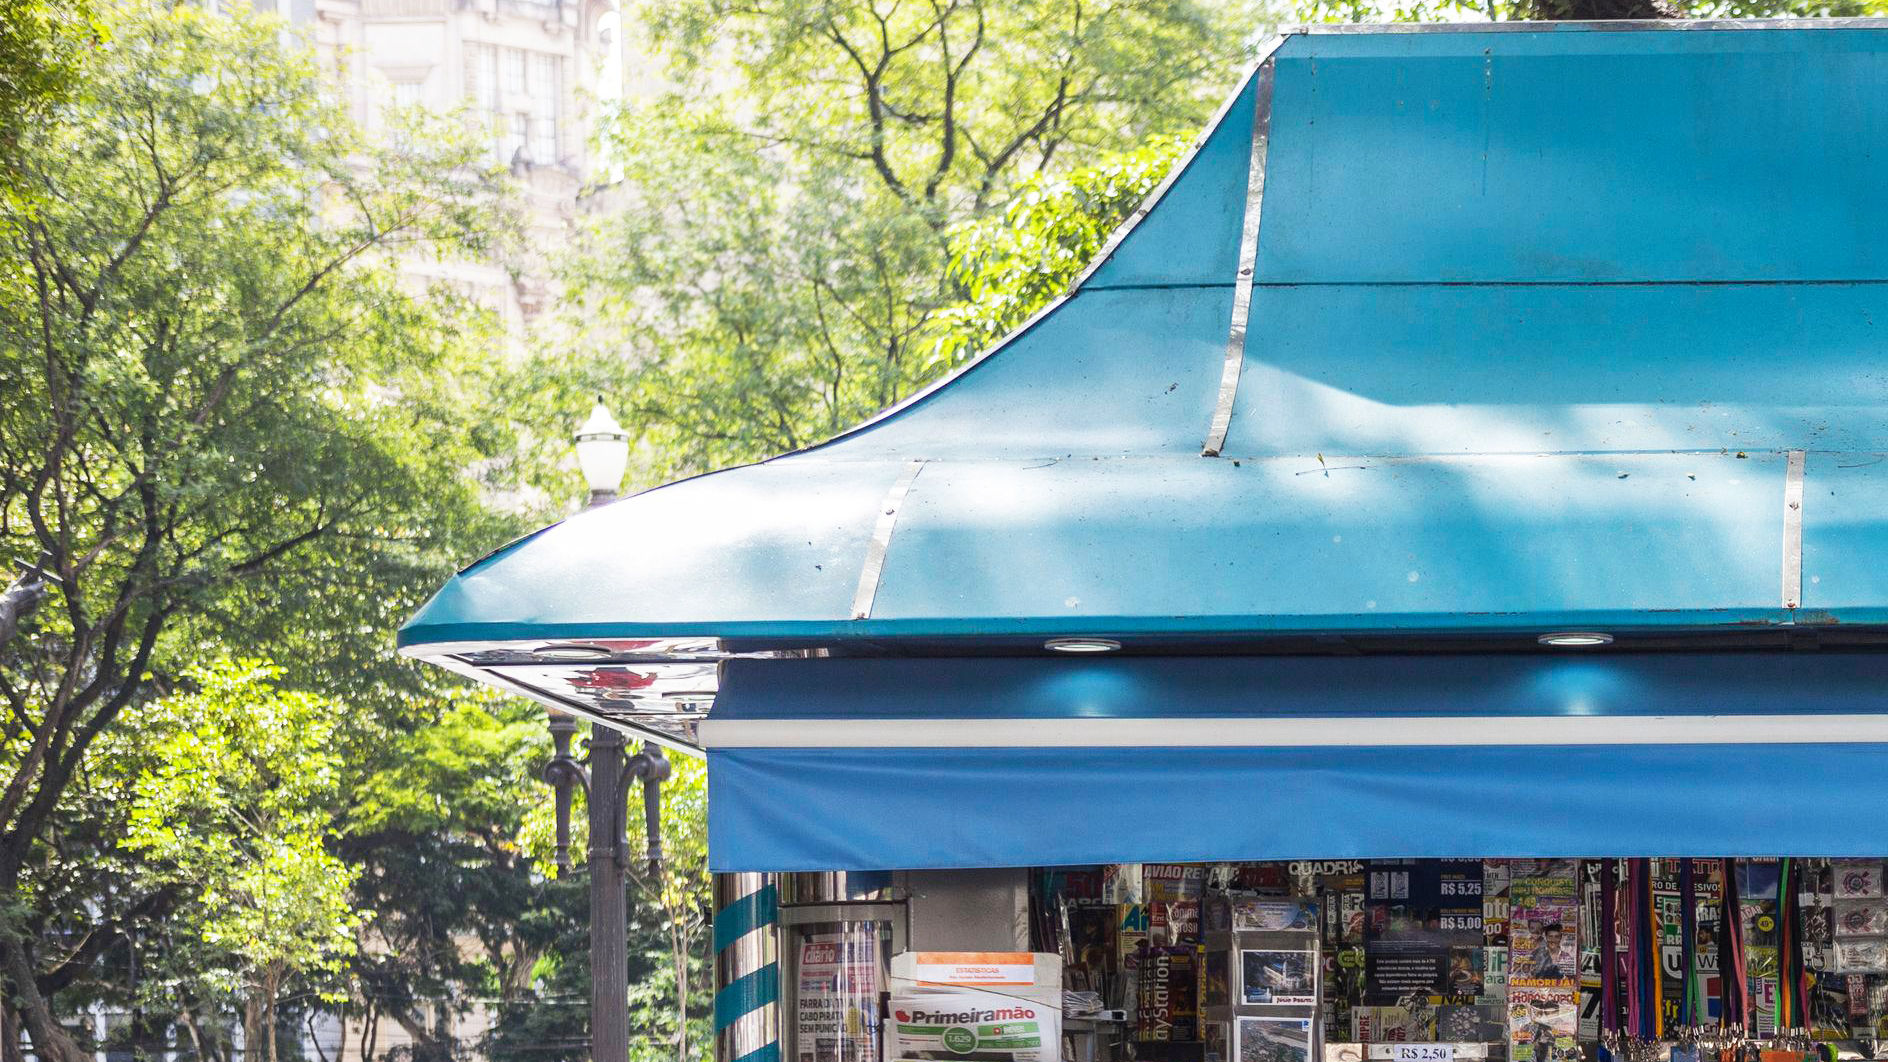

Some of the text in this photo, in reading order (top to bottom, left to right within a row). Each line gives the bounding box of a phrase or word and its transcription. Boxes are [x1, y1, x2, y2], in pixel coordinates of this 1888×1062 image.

[1441, 883, 1481, 896] R$ 5,25
[1441, 917, 1481, 930] R$ 5,00
[800, 1011, 818, 1021] CABO
[912, 1006, 1035, 1024] Primeiramão
[1402, 1048, 1446, 1061] R$ 2,50
